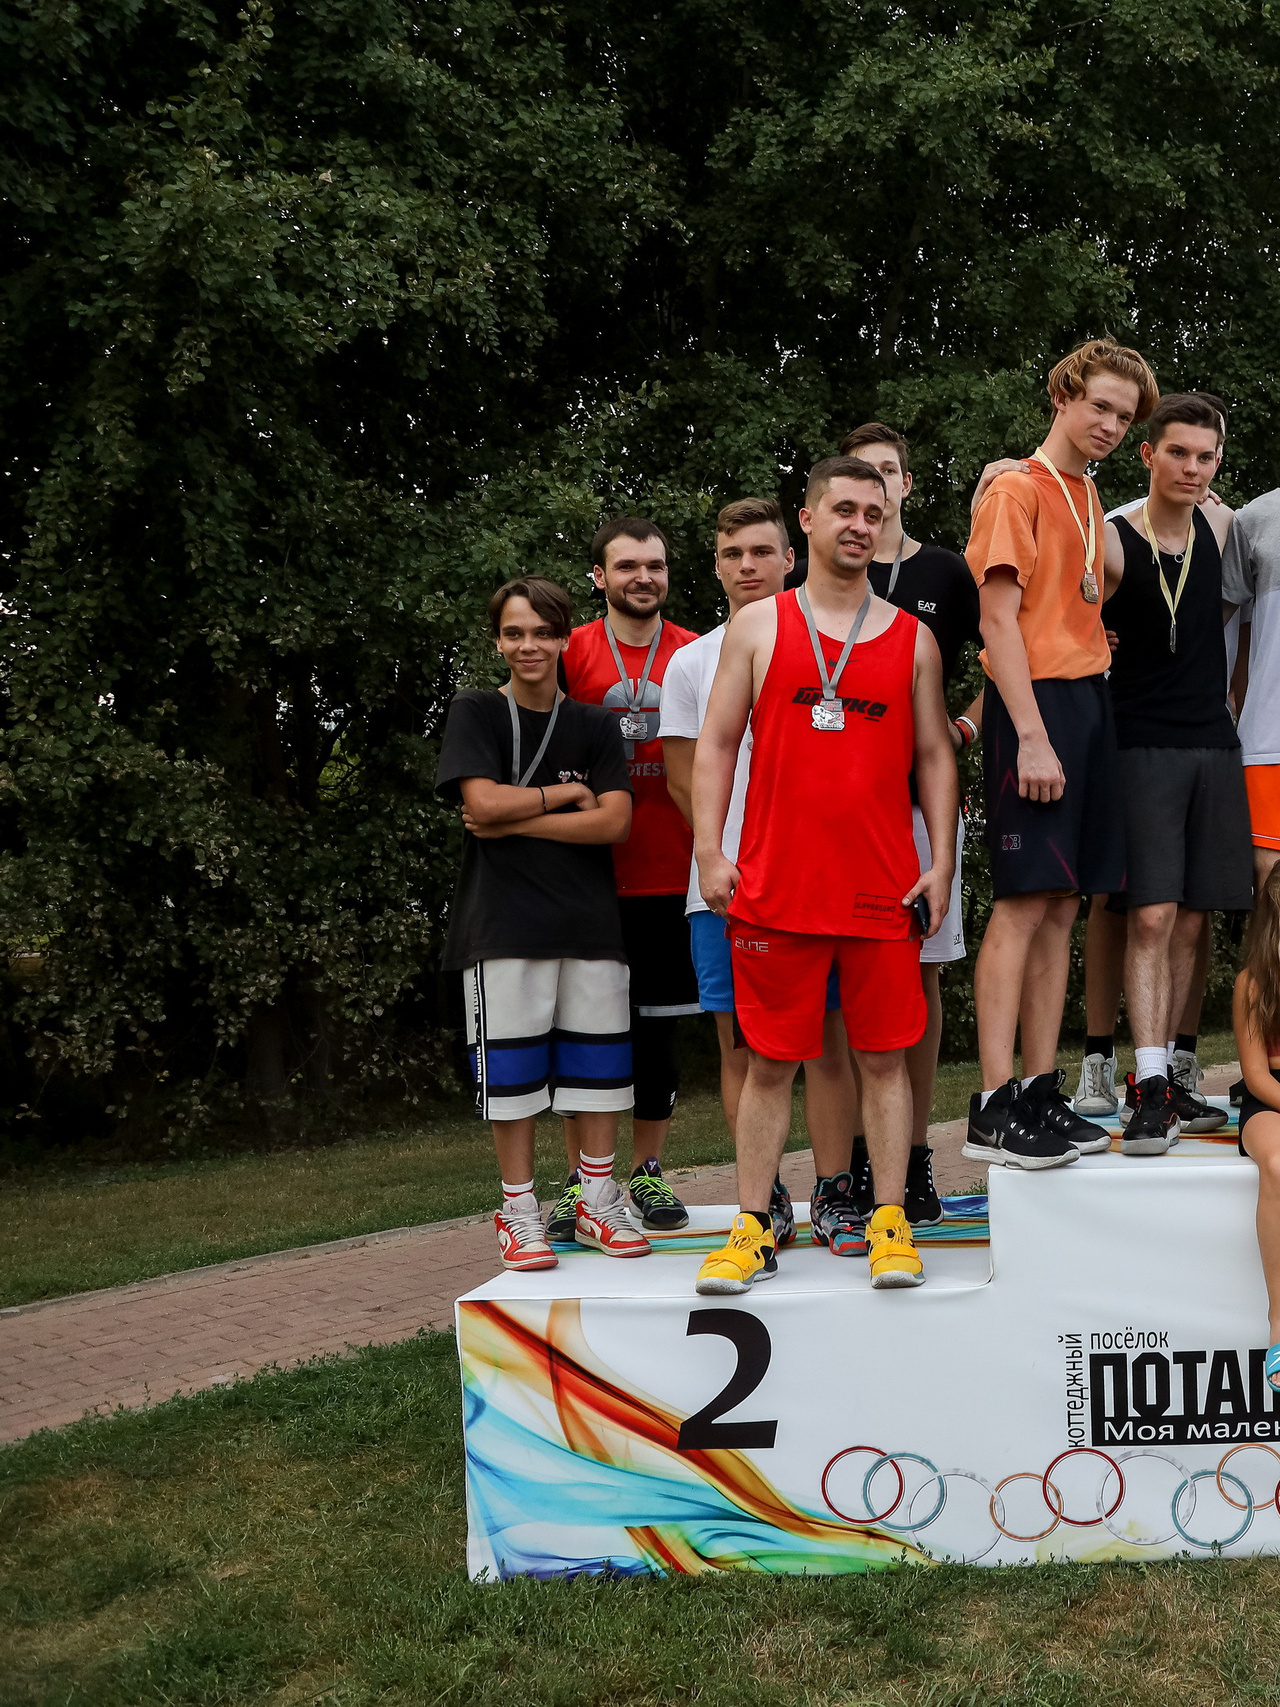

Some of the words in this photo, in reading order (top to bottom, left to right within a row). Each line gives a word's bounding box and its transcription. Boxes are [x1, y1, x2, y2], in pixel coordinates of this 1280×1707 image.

[917, 600, 937, 611] EA7
[1090, 1326, 1169, 1350] посёлок
[677, 1308, 778, 1450] 2
[1057, 1333, 1090, 1448] коттеджный
[1103, 1420, 1175, 1441] Моя
